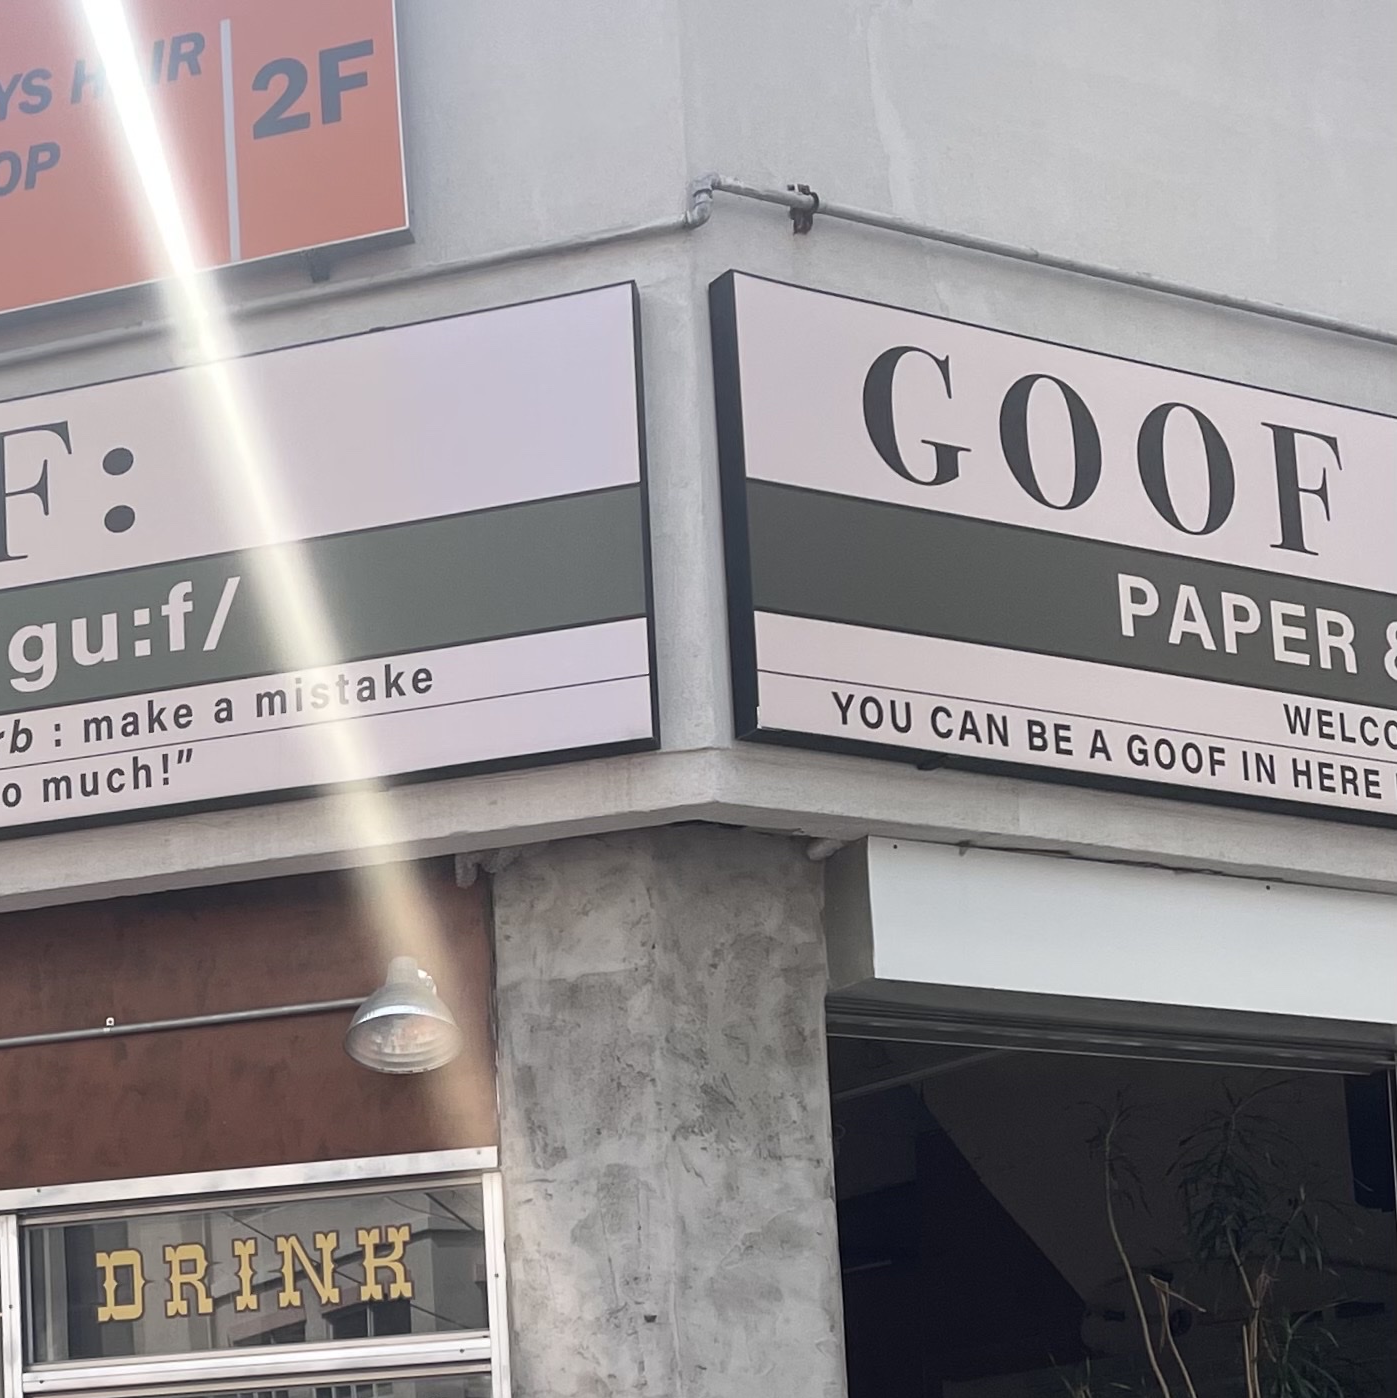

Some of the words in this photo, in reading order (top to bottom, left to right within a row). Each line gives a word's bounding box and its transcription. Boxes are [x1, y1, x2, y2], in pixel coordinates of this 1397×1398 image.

[70, 31, 206, 105] HIR
[251, 39, 374, 140] 2F
[862, 345, 1343, 556] GOOF
[1116, 572, 1358, 675] PAPER
[82, 698, 194, 745] make
[213, 695, 235, 725] a
[254, 662, 435, 719] mistake
[831, 691, 913, 734] YOU
[930, 705, 1011, 748] CAN
[1028, 718, 1074, 756] BE
[1089, 728, 1113, 762] A
[1126, 733, 1228, 778] GOOF
[1242, 751, 1276, 785] IN
[1292, 757, 1383, 800] HERE
[95, 1224, 413, 1322] DRINK
